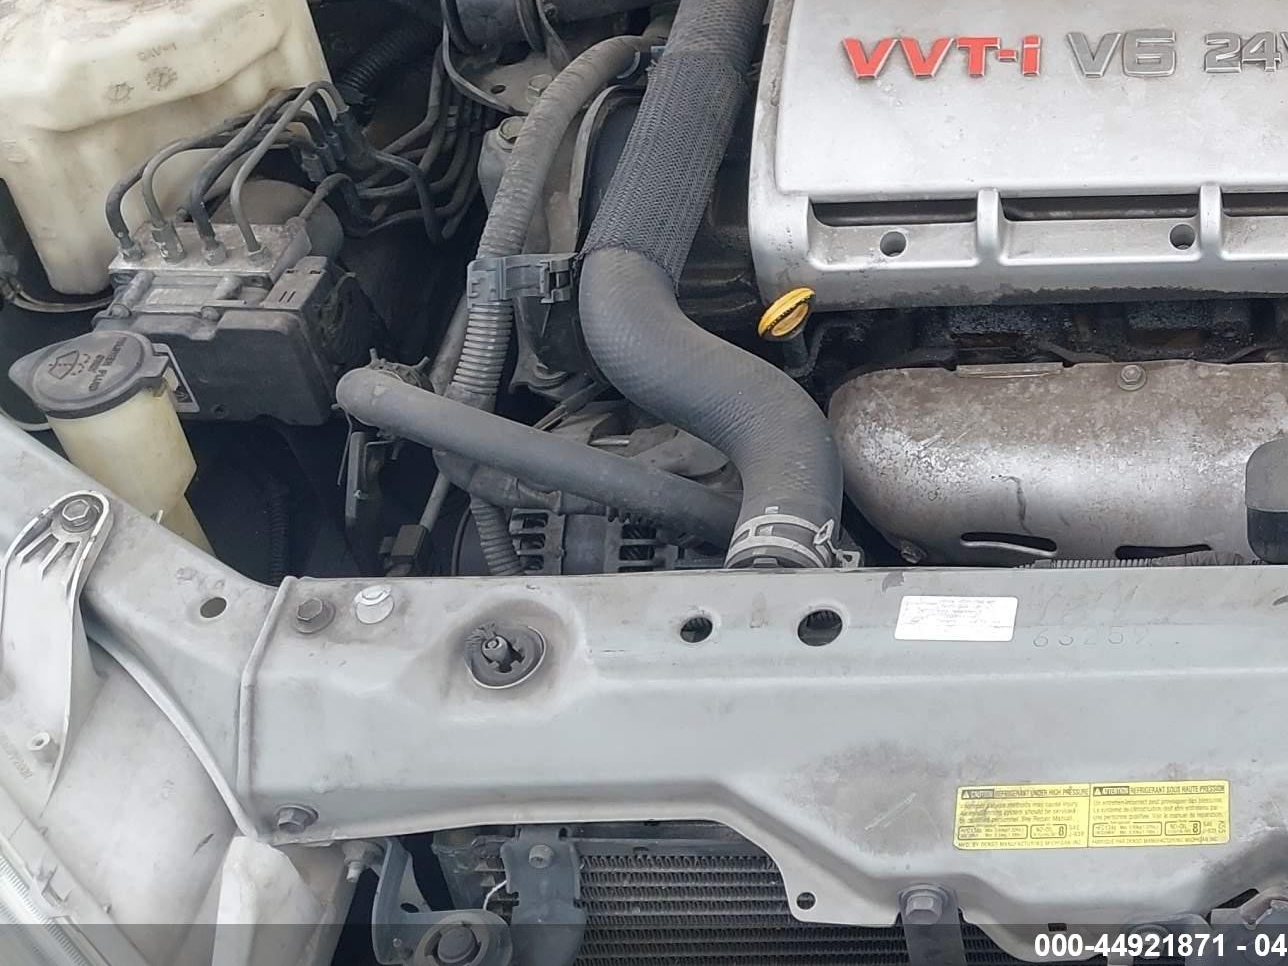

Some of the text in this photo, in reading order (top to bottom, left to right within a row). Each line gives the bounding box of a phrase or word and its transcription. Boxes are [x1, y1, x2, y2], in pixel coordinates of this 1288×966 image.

[841, 34, 1042, 79] VVT-i
[1068, 29, 1177, 78] V6
[1192, 822, 1198, 834] 8
